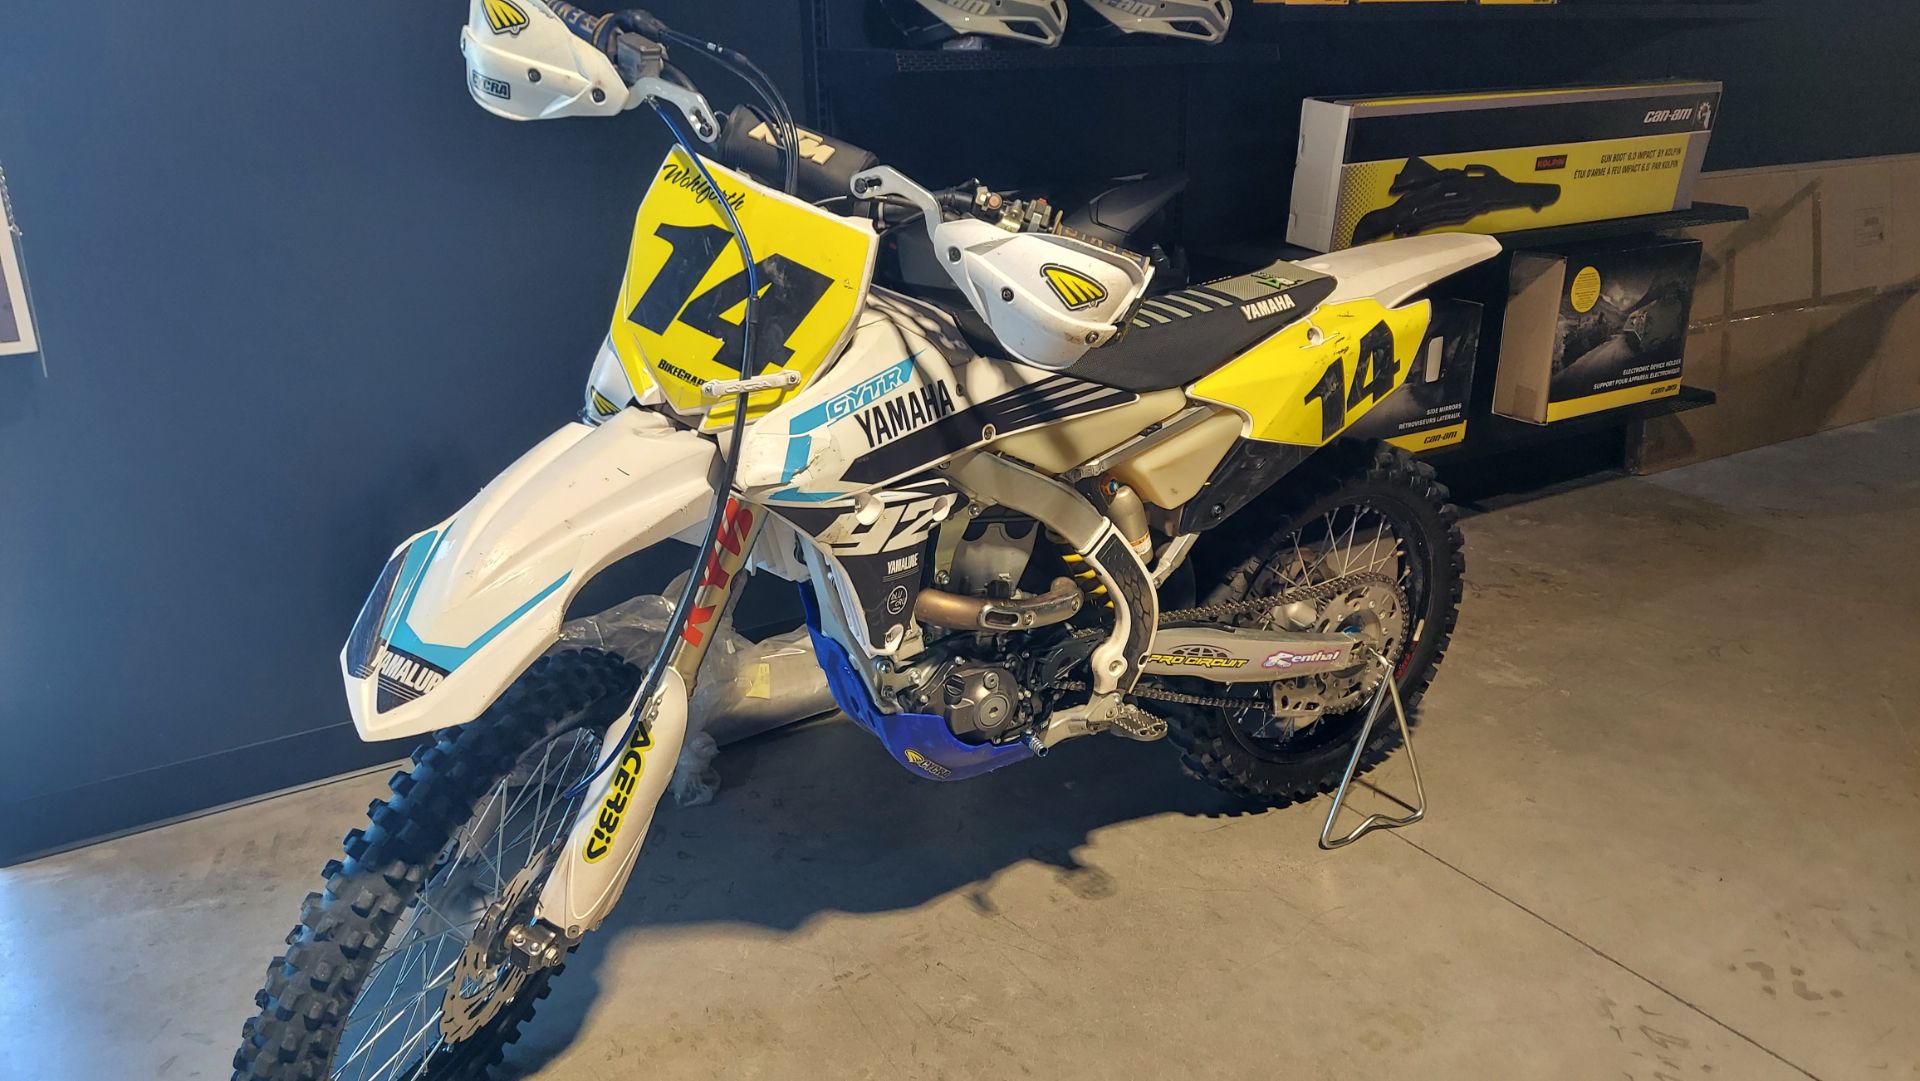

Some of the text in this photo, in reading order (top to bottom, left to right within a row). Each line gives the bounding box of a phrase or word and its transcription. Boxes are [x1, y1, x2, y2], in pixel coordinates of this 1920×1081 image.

[472, 71, 509, 98] CCRA
[1644, 107, 1692, 123] can-am
[1637, 149, 1656, 160] IMPACT
[627, 222, 836, 376] 14
[1240, 294, 1296, 320] YAMAHA
[826, 366, 903, 420] GYTR
[1304, 319, 1401, 442] 14
[854, 379, 956, 449] YAMAHA
[1426, 402, 1463, 416] SIDE MIRRORS
[1423, 430, 1458, 445] can-am
[371, 645, 445, 694] YAMALUB
[1148, 653, 1250, 669] PRO CIRCUIT
[1262, 650, 1341, 669] Renthal
